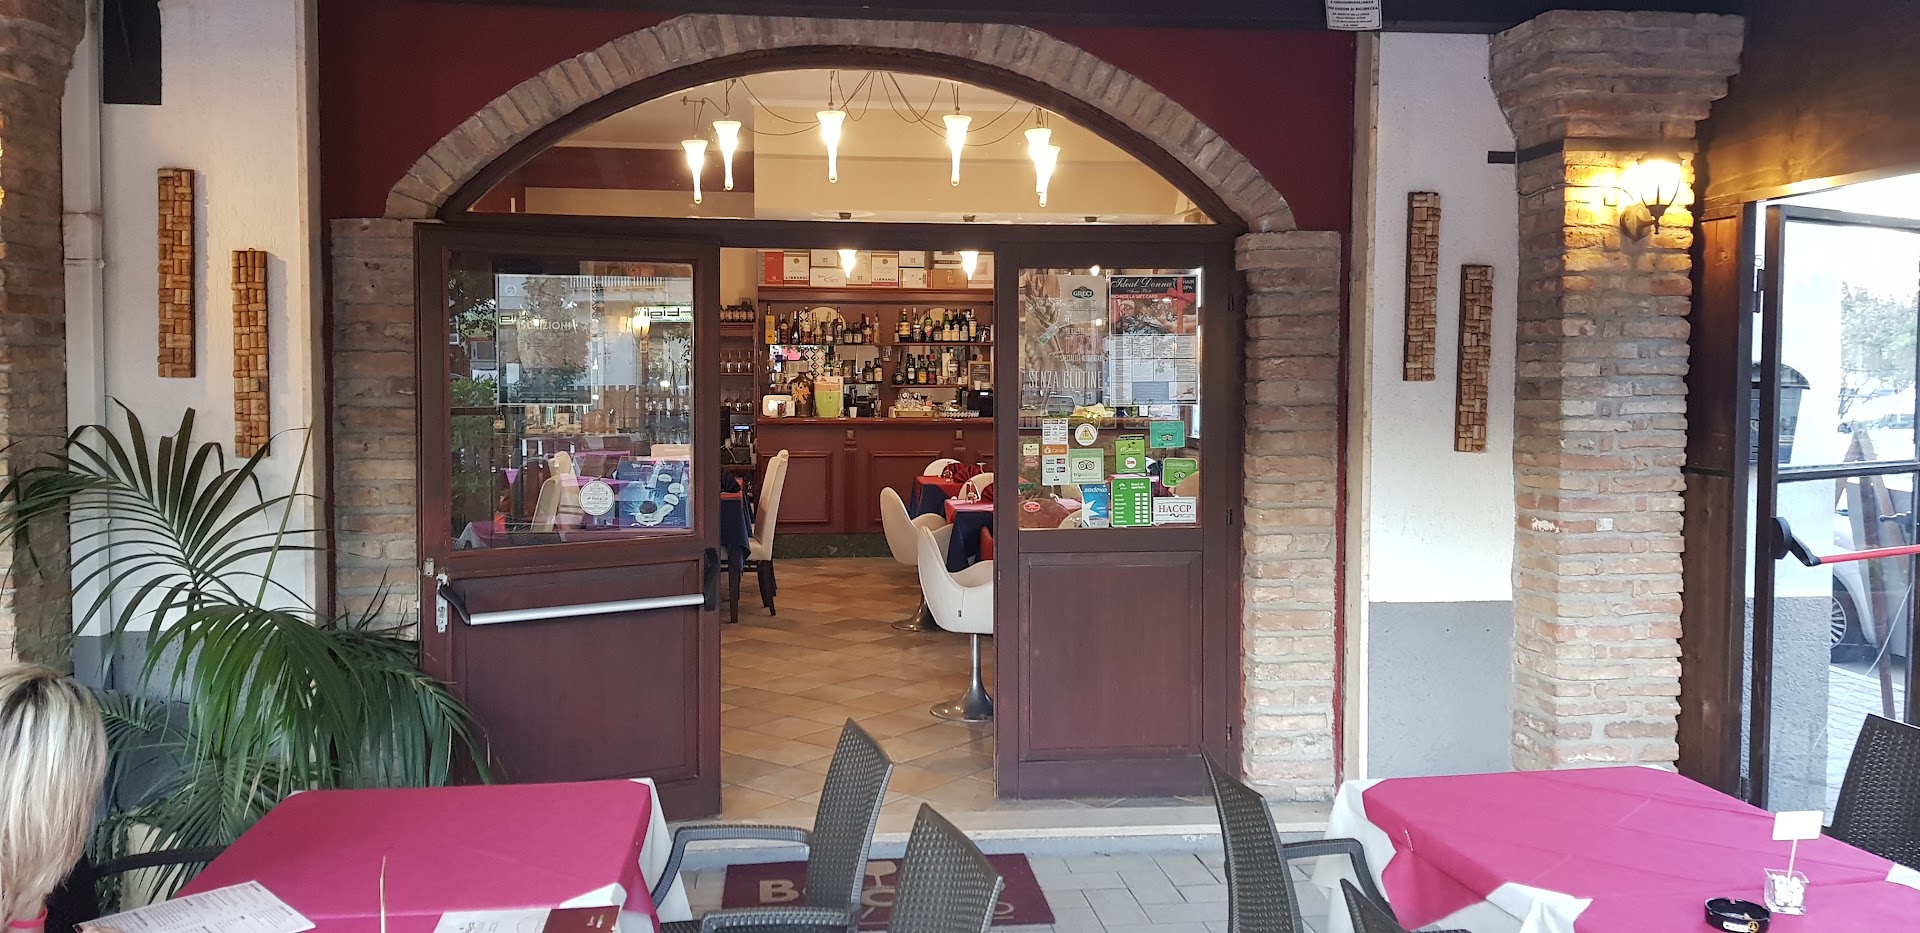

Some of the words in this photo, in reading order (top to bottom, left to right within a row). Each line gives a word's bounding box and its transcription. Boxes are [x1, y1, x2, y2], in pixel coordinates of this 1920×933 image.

[1111, 277, 1140, 288] Ideal
[1140, 277, 1172, 288] Donna
[518, 321, 572, 330] ISCIZIONI
[1028, 370, 1060, 389] SENZA
[1063, 370, 1103, 389] GLUTINE
[1158, 504, 1192, 513] HACCP
